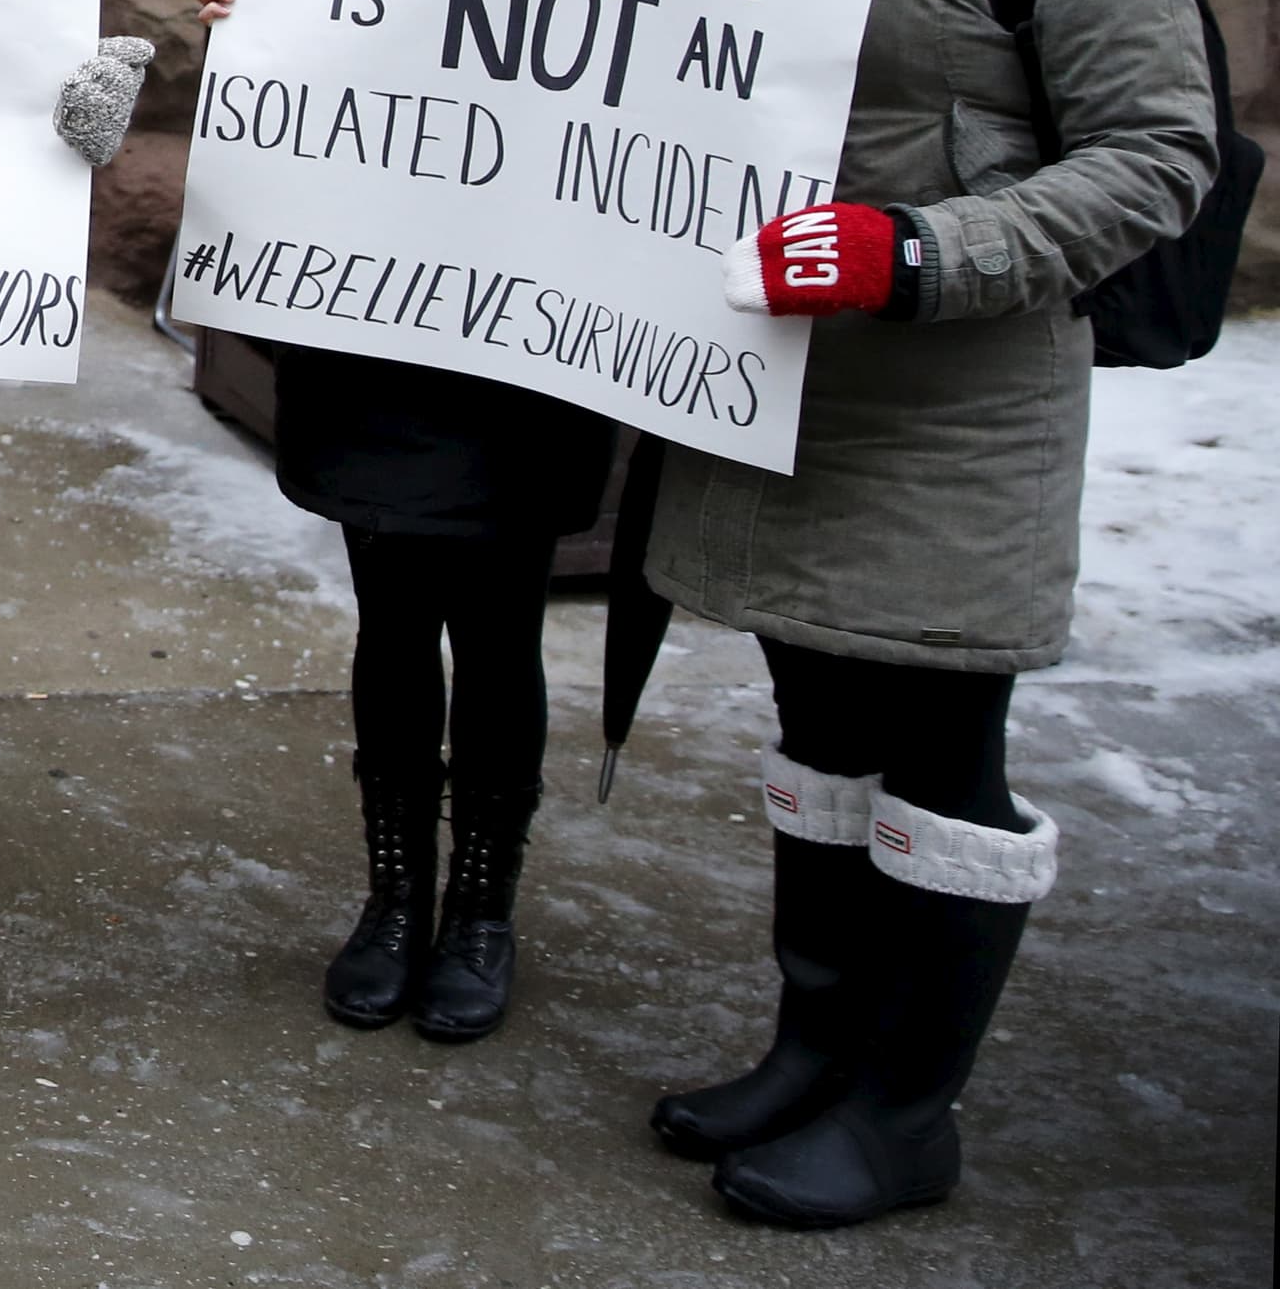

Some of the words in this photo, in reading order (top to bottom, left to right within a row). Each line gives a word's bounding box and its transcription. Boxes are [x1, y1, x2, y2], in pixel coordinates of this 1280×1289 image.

[677, 16, 764, 101] AN
[199, 71, 506, 187] ISOLATED
[781, 210, 840, 288] CAN
[183, 230, 766, 428] #WEBELIEVESURVIVORS
